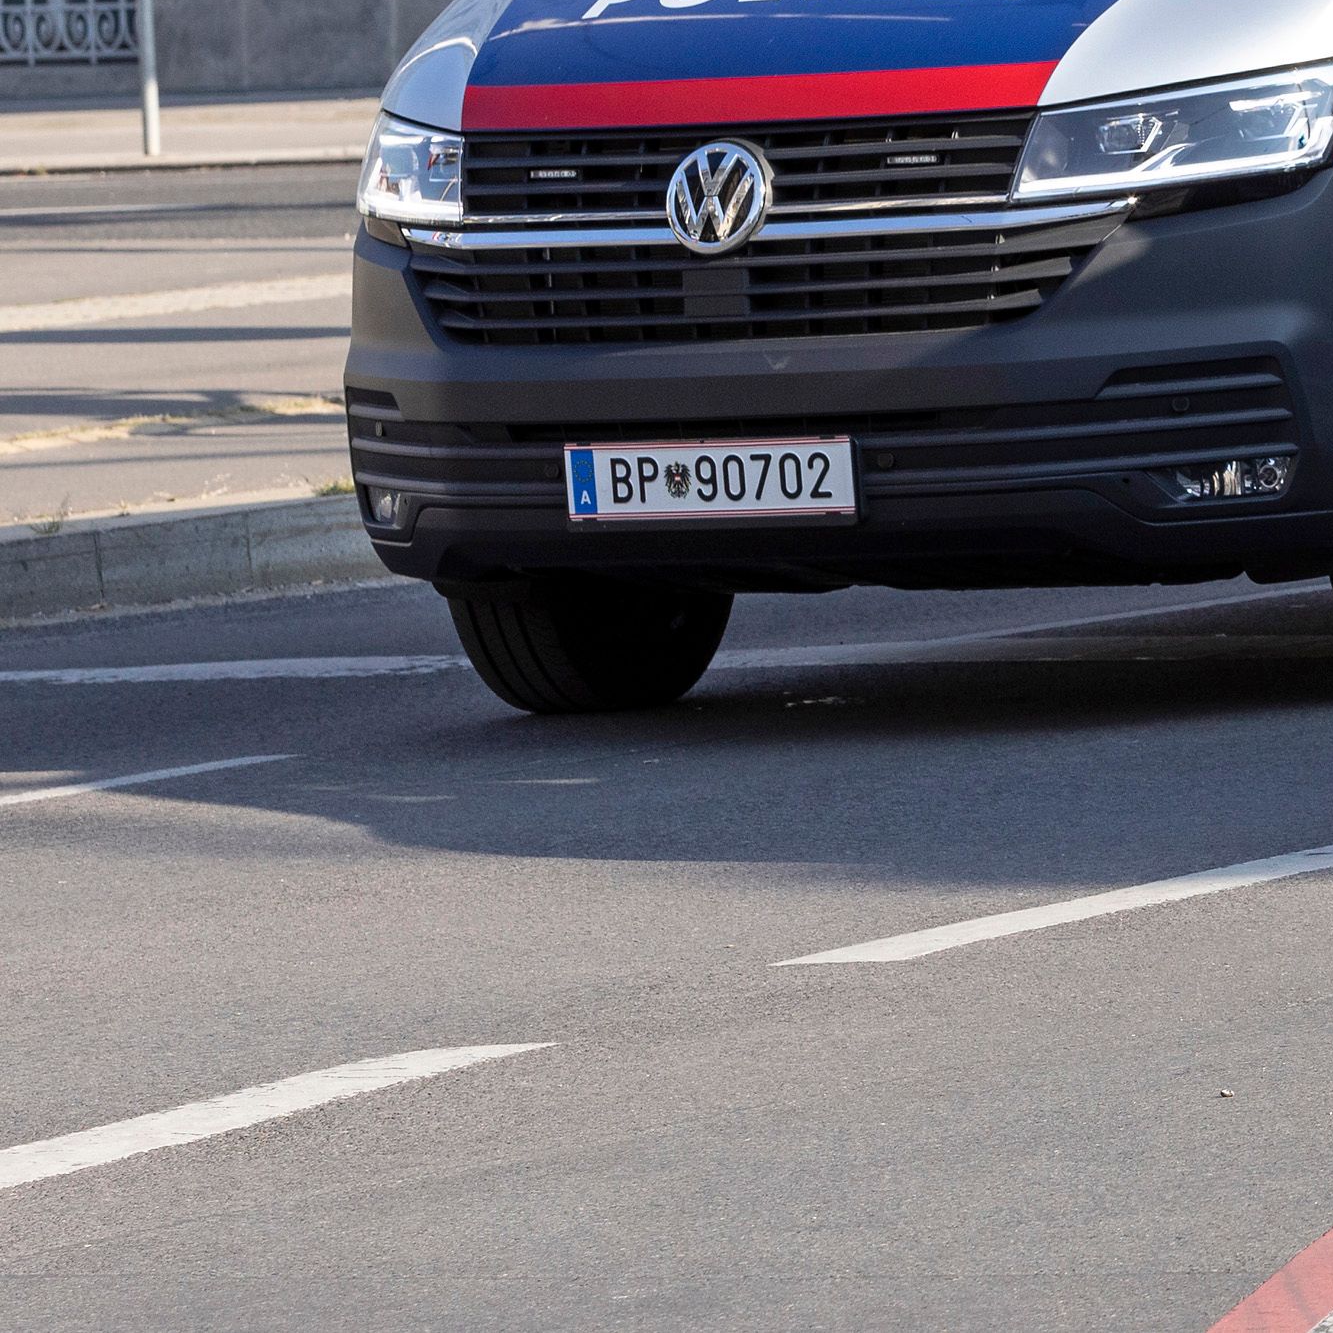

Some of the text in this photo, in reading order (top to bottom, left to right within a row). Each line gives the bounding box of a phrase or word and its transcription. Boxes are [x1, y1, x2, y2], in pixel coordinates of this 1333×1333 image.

[667, 141, 768, 252] VW
[580, 489, 591, 505] A
[610, 452, 833, 504] BP 90702
